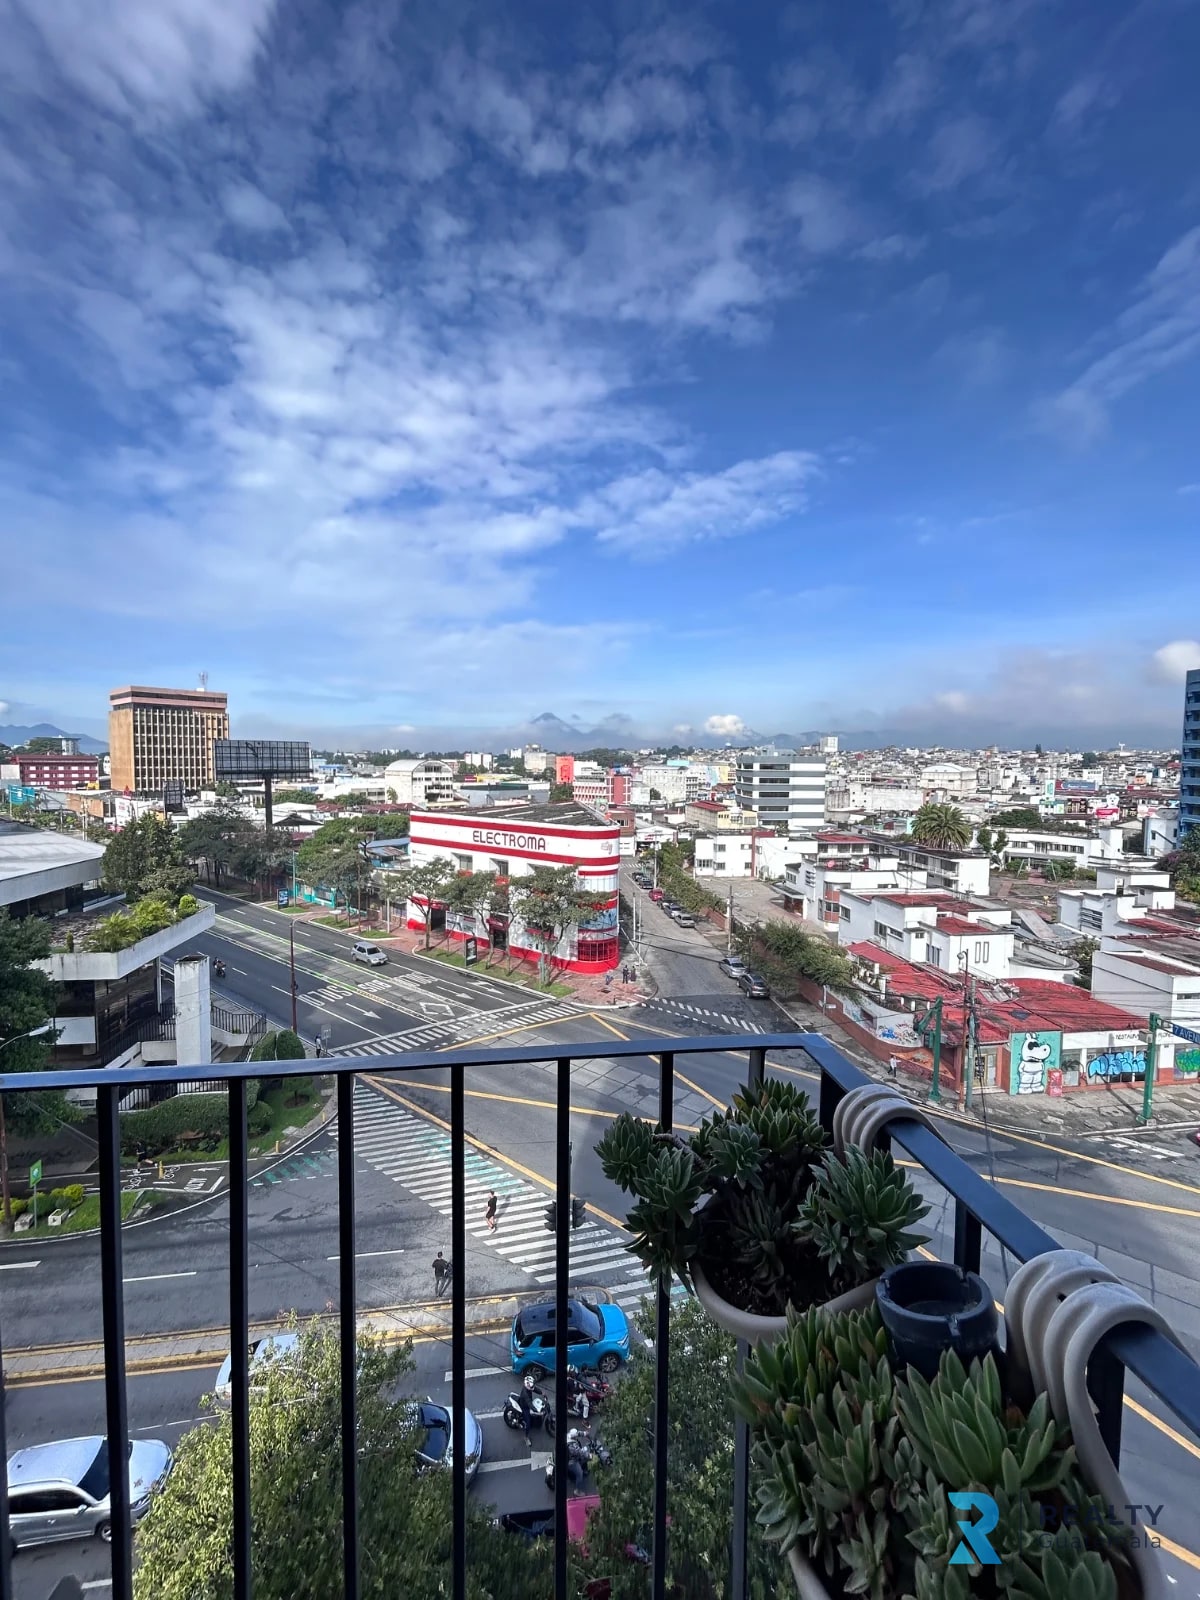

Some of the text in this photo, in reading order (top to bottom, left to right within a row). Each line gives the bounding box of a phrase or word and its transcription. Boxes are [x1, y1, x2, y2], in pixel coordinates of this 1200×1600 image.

[472, 830, 546, 851] ELECTROMA
[297, 985, 353, 1006] SOLO
[358, 979, 392, 993] BUS
